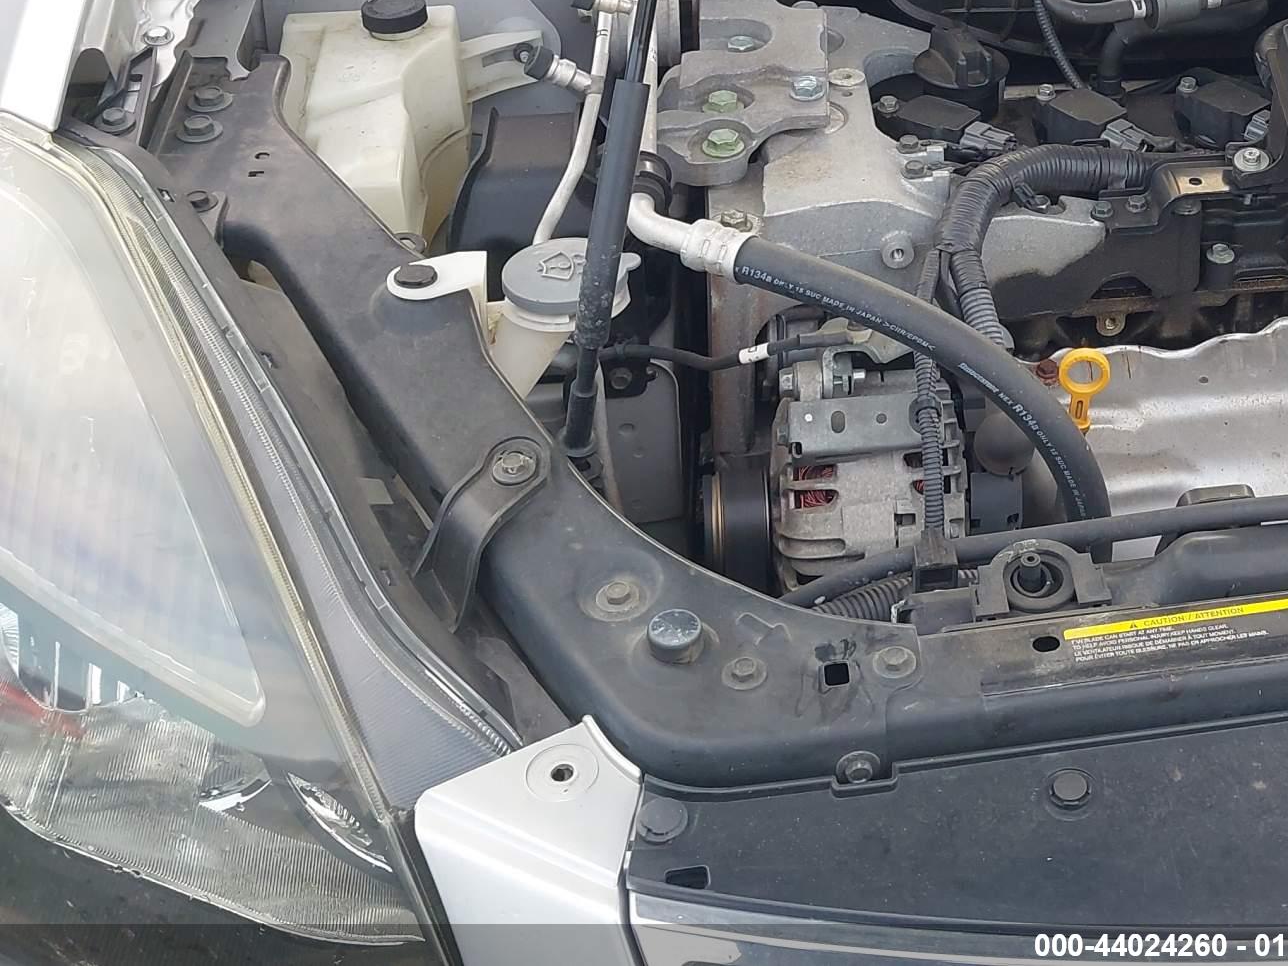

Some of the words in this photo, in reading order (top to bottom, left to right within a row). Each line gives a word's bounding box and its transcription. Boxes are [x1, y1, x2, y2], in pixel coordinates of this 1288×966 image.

[742, 266, 772, 283] R134a
[773, 278, 794, 290] ONLY
[823, 296, 845, 308] MADE
[846, 305, 855, 313] IN
[856, 310, 882, 323] JAPAN
[998, 392, 1014, 406] NEX
[1012, 404, 1039, 431] R134a
[1036, 430, 1052, 447] ONLY
[1063, 469, 1077, 487] MADE
[1144, 616, 1184, 626] CAUTION
[1196, 607, 1244, 618] ATTENTION
